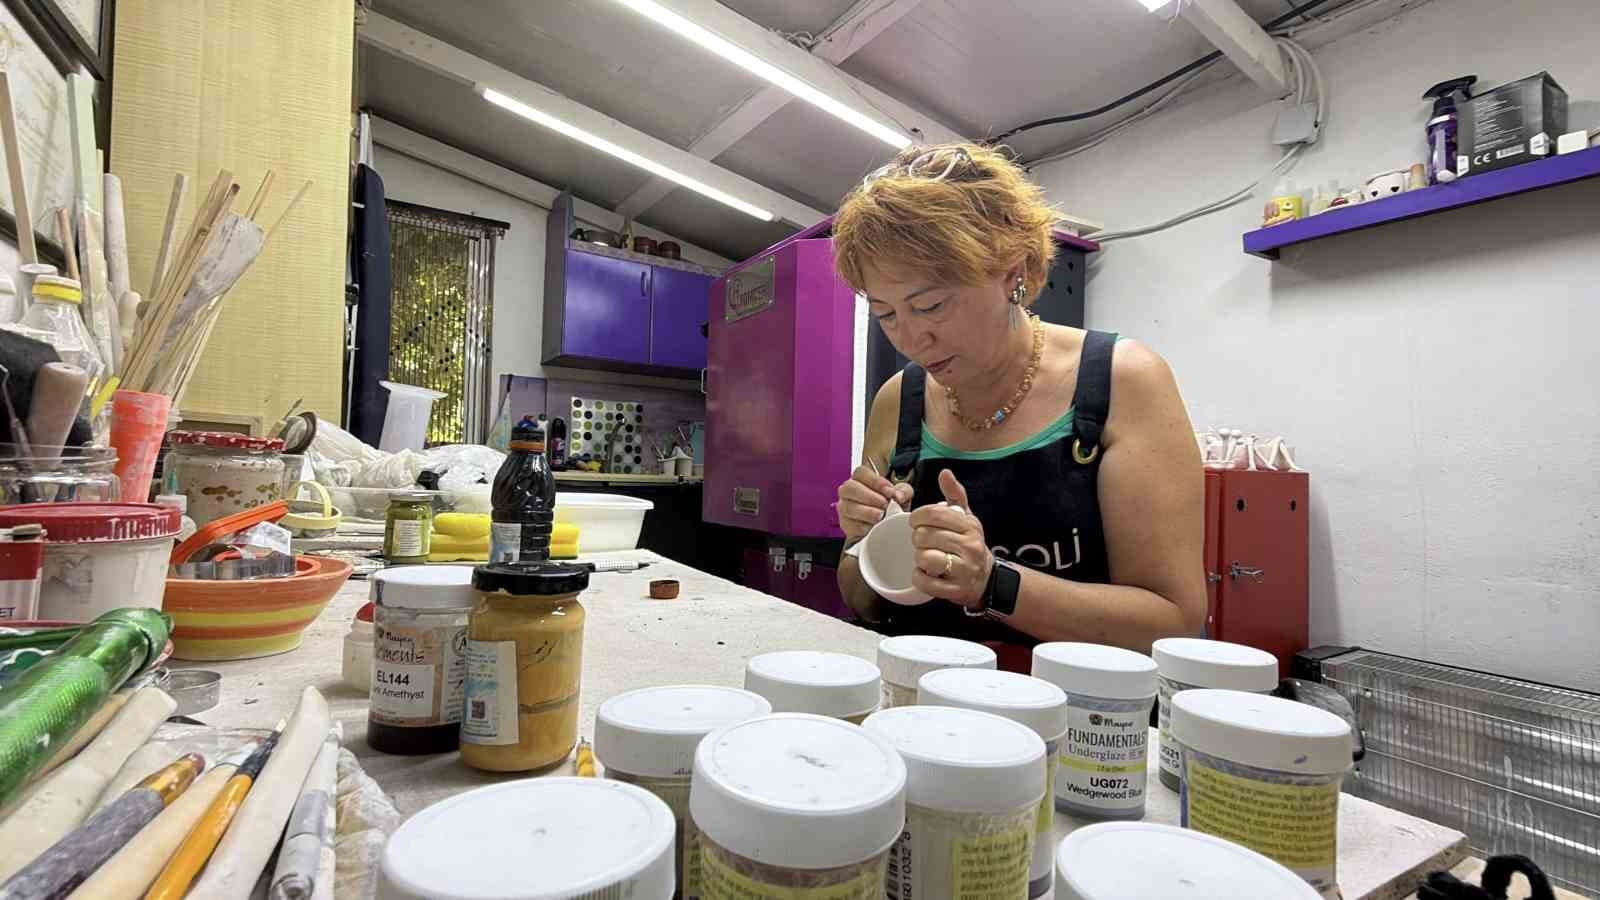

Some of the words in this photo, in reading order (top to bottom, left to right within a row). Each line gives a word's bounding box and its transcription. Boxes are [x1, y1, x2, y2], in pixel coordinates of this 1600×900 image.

[376, 670, 410, 686] EL144
[382, 687, 425, 701] Amethyst
[1068, 727, 1148, 749] FUNDAMENTALS
[1068, 743, 1126, 761] Underglaze
[1066, 782, 1127, 800] Wedgewood
[1089, 776, 1129, 789] UG072
